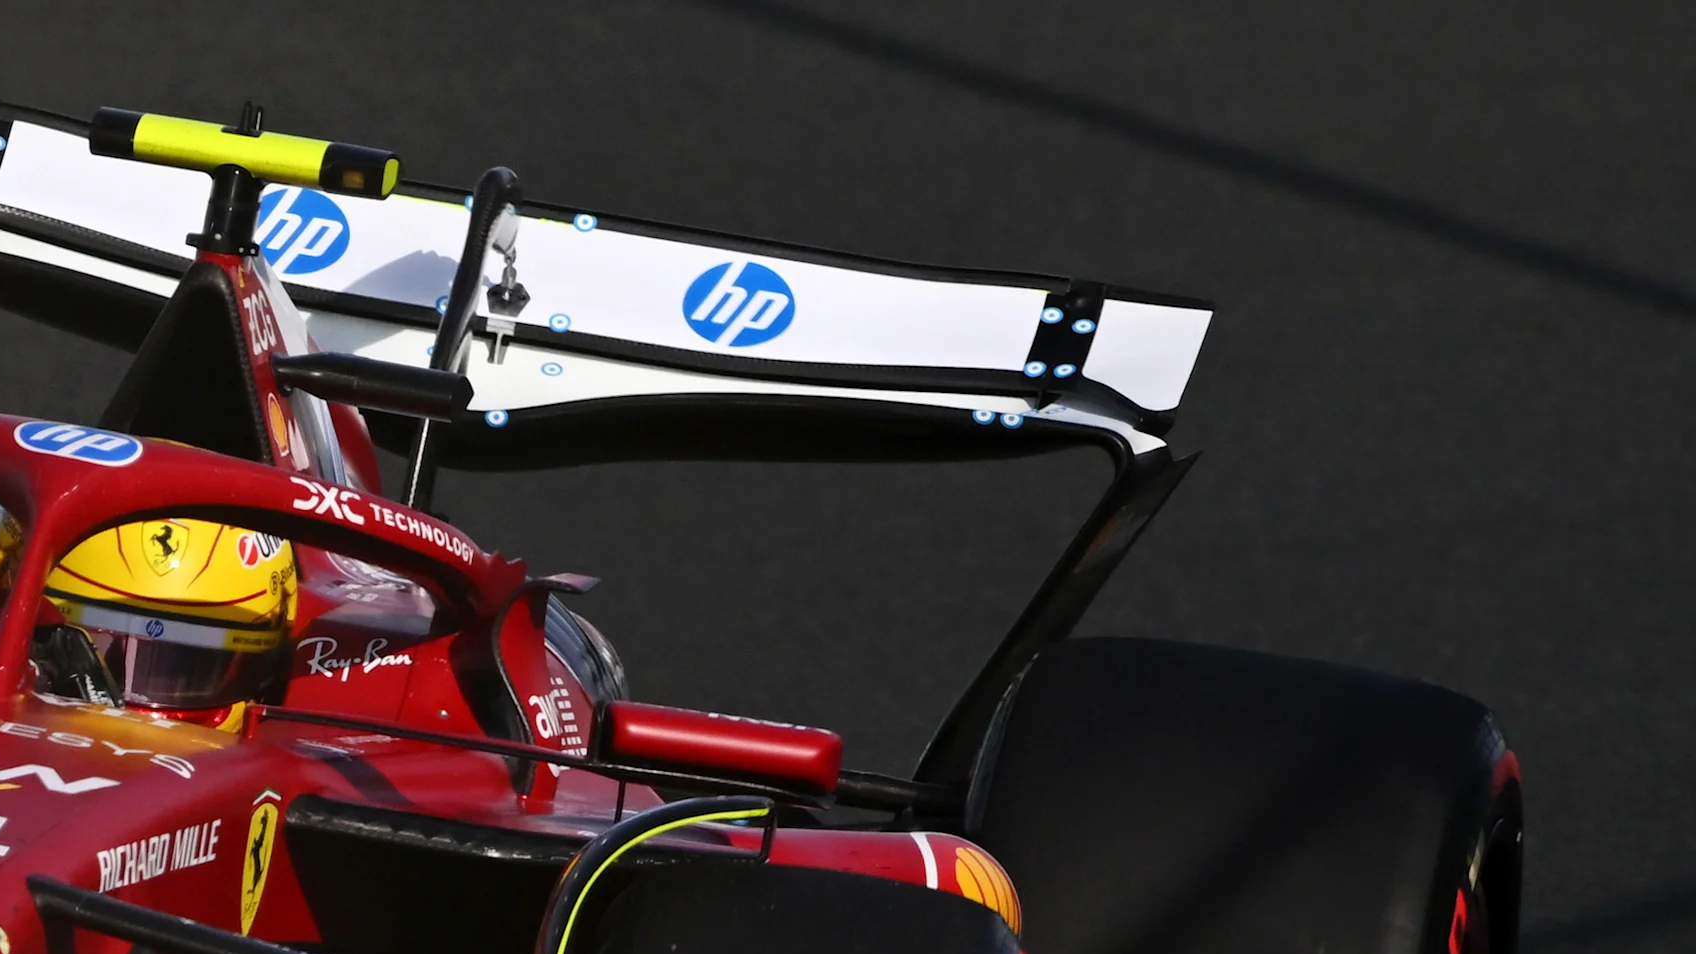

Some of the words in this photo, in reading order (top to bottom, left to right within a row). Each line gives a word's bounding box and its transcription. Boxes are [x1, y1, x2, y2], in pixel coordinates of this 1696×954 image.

[254, 188, 344, 274] hp
[690, 262, 785, 347] hp
[28, 422, 129, 464] hp
[290, 476, 365, 525] DXC
[369, 502, 475, 566] TECHNOLOGY
[146, 620, 164, 638] hp
[297, 636, 412, 681] Ray-Ban
[96, 832, 171, 894] RICHARD
[170, 818, 222, 872] MILLE
